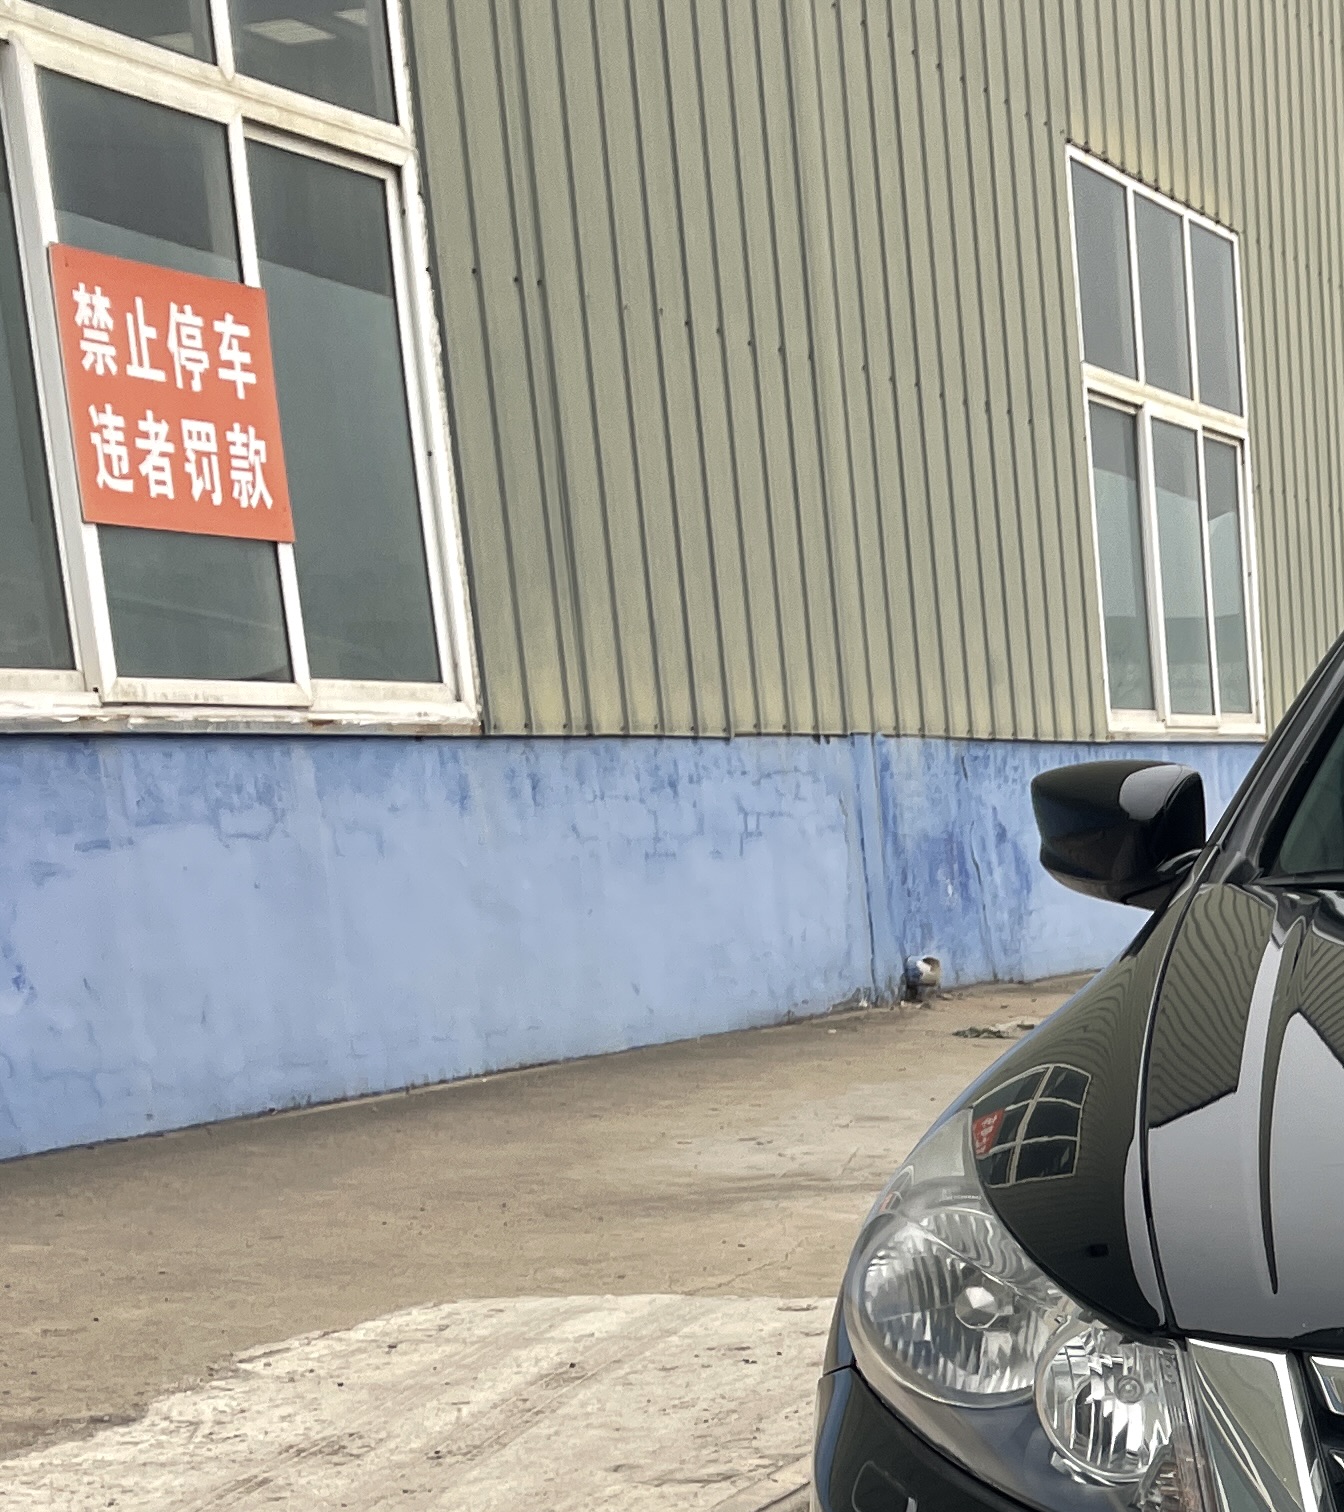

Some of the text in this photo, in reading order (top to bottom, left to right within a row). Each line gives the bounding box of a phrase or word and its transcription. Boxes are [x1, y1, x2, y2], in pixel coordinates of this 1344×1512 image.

[71, 281, 257, 400] 禁止停车
[87, 402, 274, 510] 违者罚款
